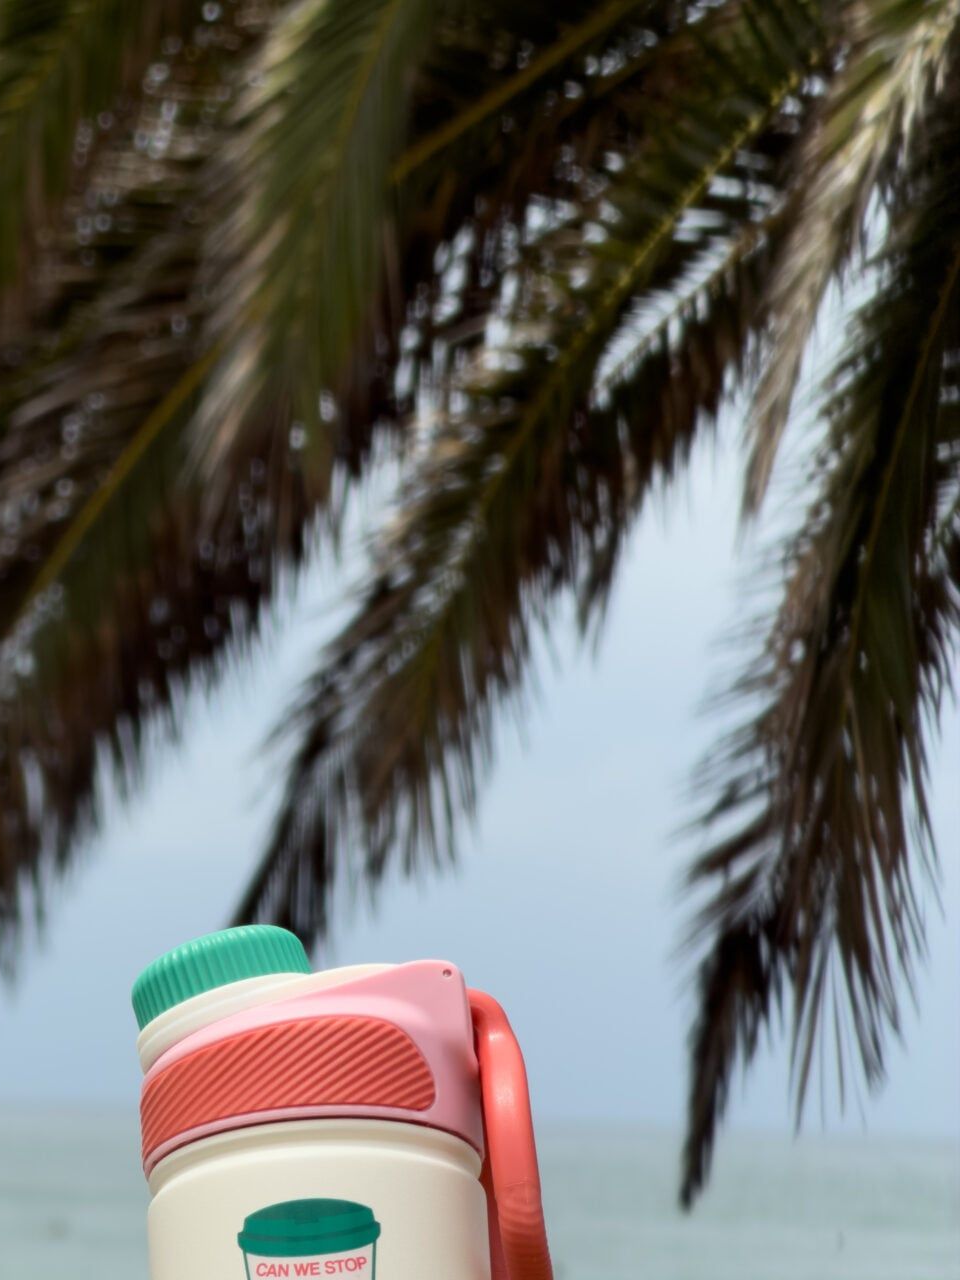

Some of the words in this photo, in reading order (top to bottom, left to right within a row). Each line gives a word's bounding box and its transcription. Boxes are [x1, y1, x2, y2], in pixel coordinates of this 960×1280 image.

[256, 1262, 289, 1278] CAN
[294, 1261, 320, 1277] WE
[325, 1256, 367, 1274] STOP
